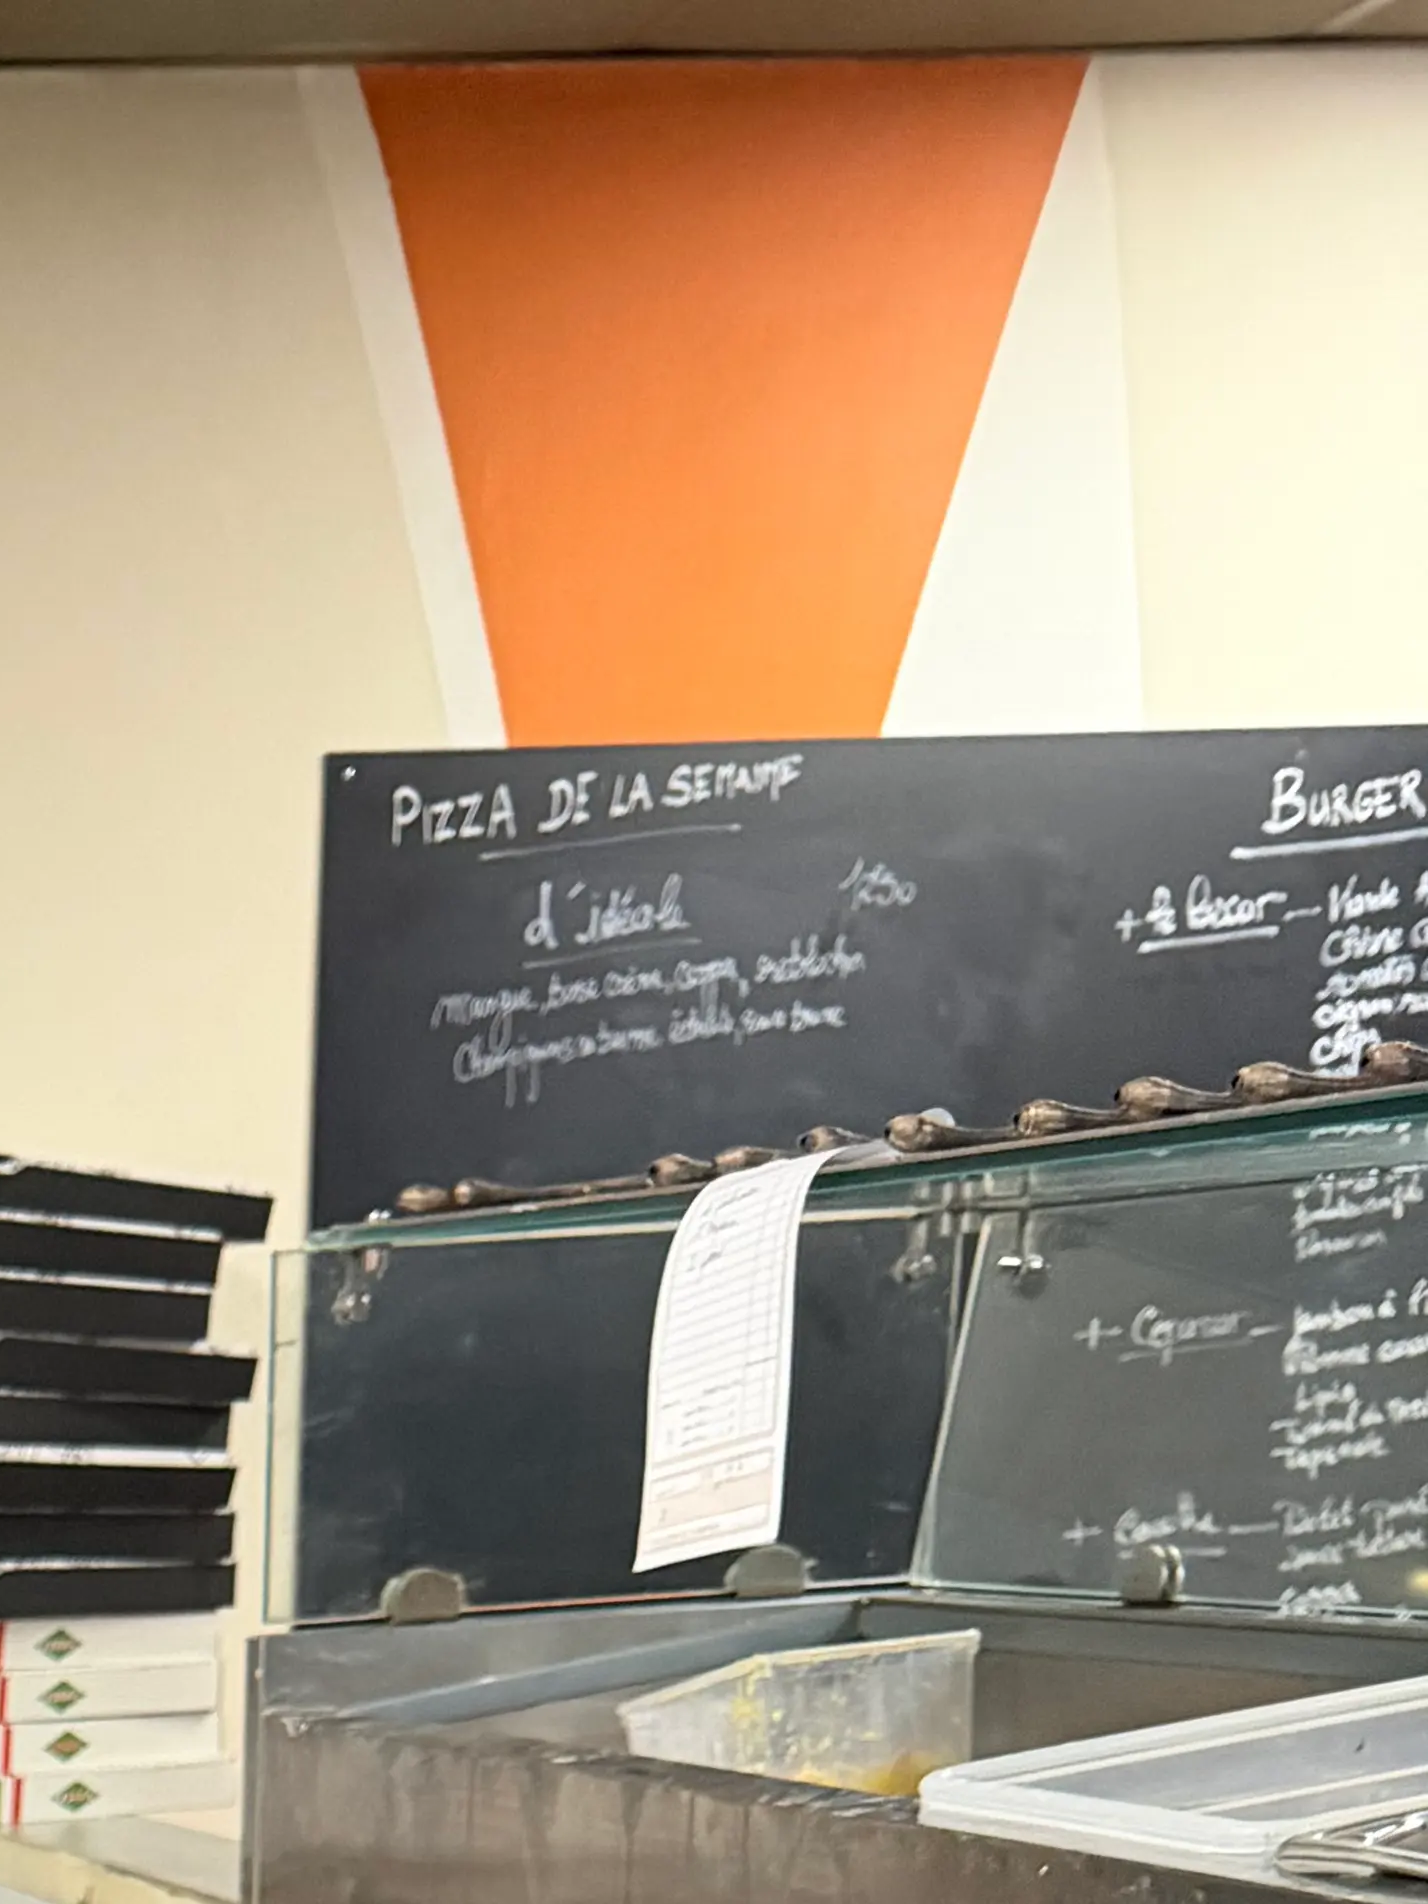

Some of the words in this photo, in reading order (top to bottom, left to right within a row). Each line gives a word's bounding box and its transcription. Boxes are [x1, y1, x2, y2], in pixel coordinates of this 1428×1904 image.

[391, 783, 517, 846] PIZZA
[538, 770, 599, 834] DE
[608, 772, 654, 819] LA
[1261, 766, 1427, 834] BURGER
